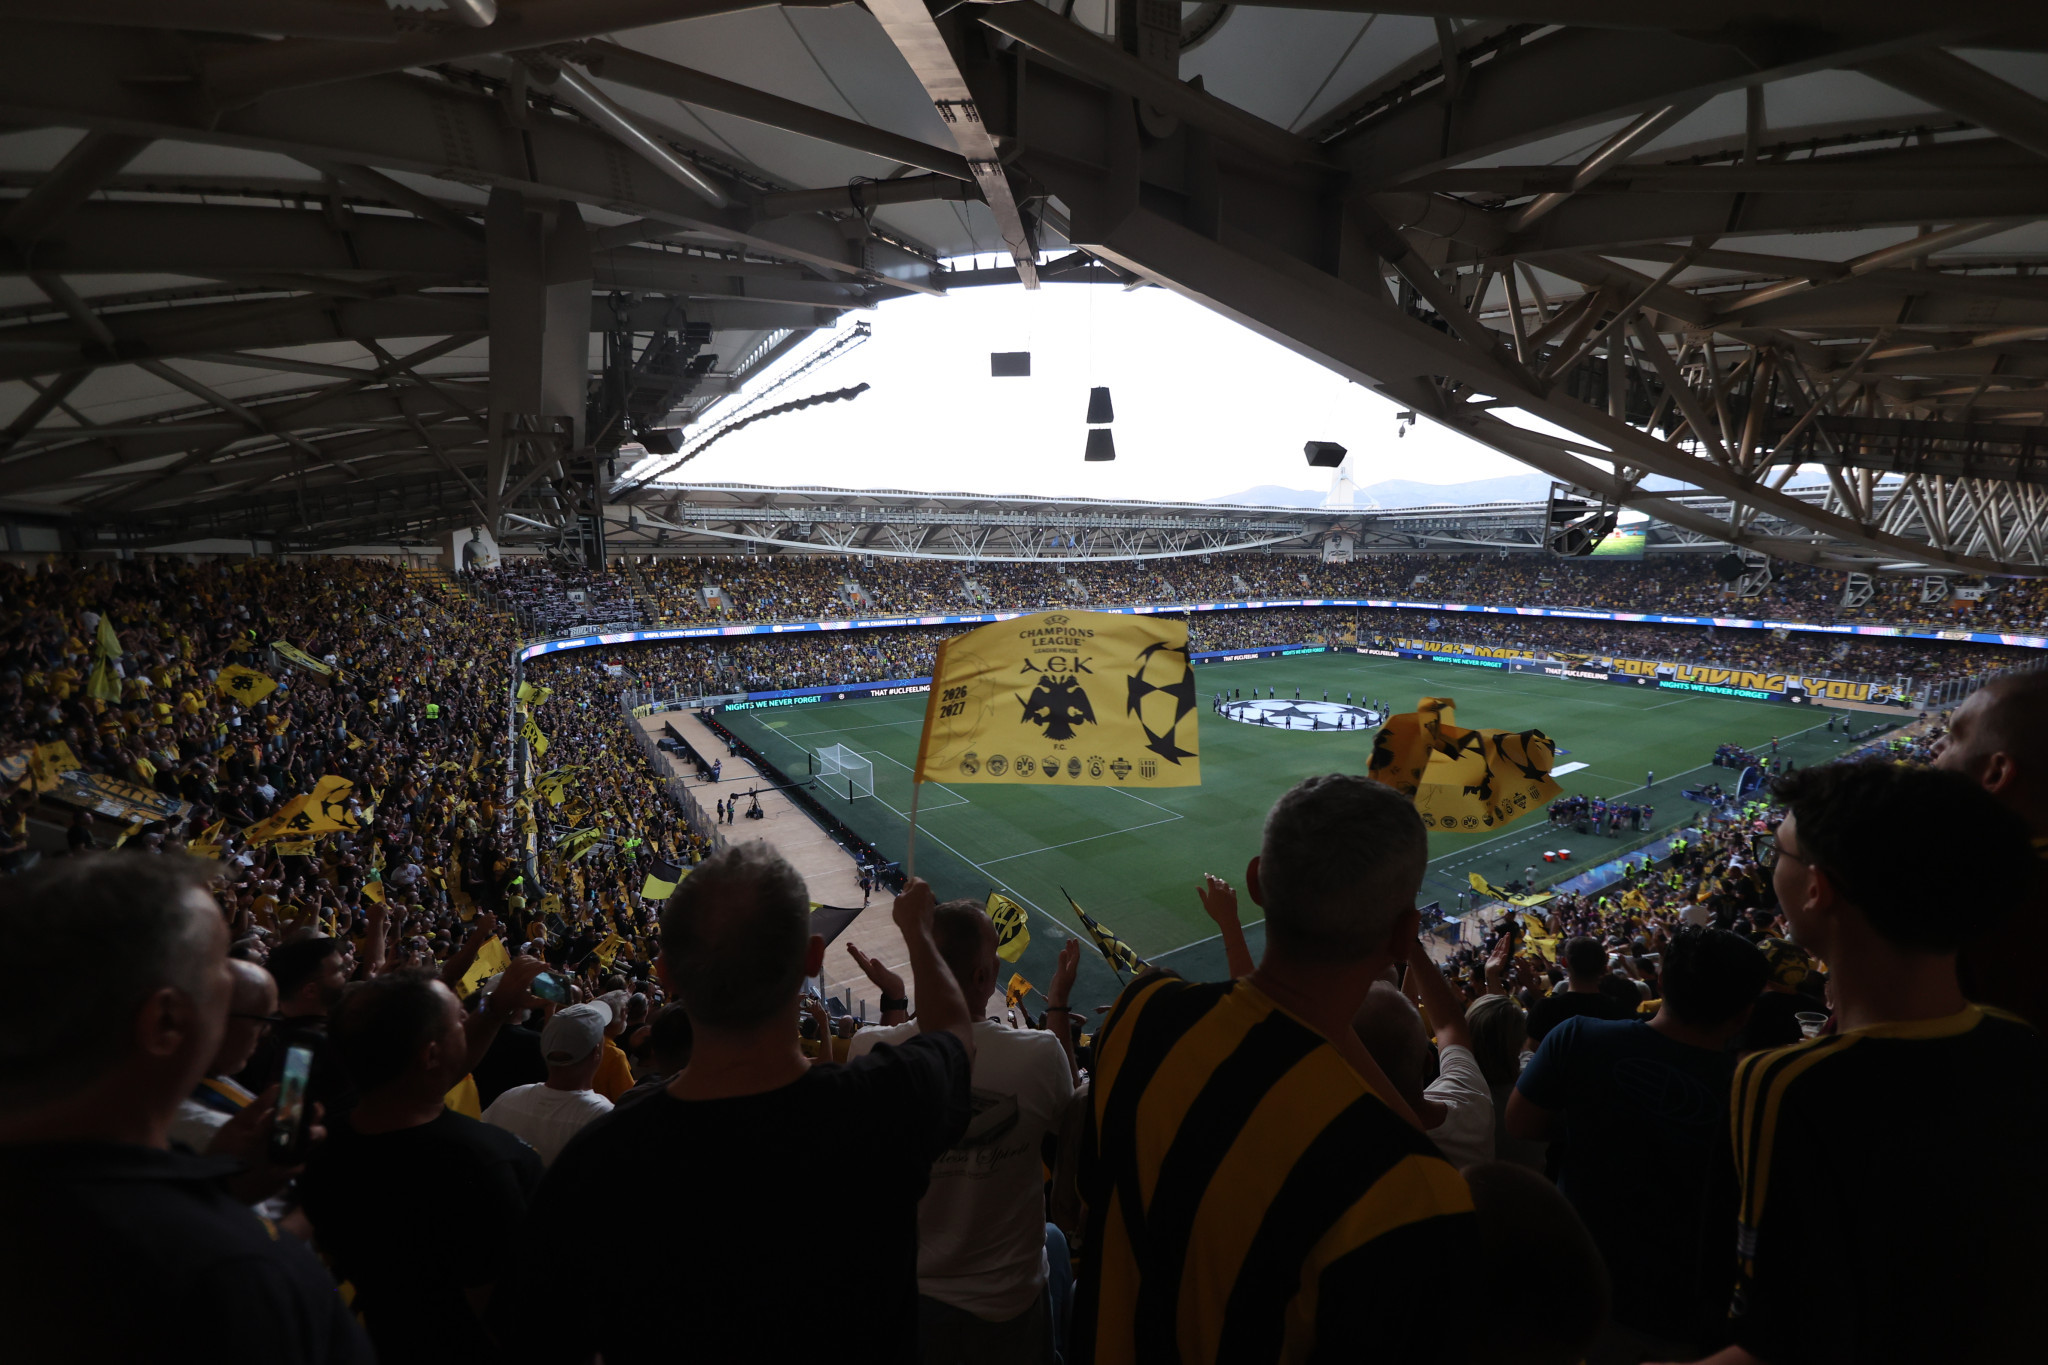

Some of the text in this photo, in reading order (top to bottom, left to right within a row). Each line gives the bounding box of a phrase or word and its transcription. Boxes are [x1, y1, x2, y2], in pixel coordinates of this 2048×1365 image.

[659, 630, 695, 638] CHAMPIONS
[1019, 627, 1094, 639] CHAMPIONS
[1032, 637, 1082, 646] LEAGUE
[1480, 660, 1502, 668] FORGET
[1544, 667, 1608, 680] THAT #UCLFEELING
[1612, 658, 1660, 677] FOR
[1676, 665, 1786, 692] LOVING
[1802, 678, 1870, 701] YOU
[871, 684, 931, 697] THAT #UCLFEELING
[942, 685, 968, 702] 2026
[1660, 680, 1771, 699] NIGHTS WE NEVER FORGET
[725, 695, 822, 712] NIGHTS WE NEVER FORGET
[940, 701, 966, 719] 2027
[1016, 757, 1034, 771] BVB
[1463, 816, 1477, 825] BVB
